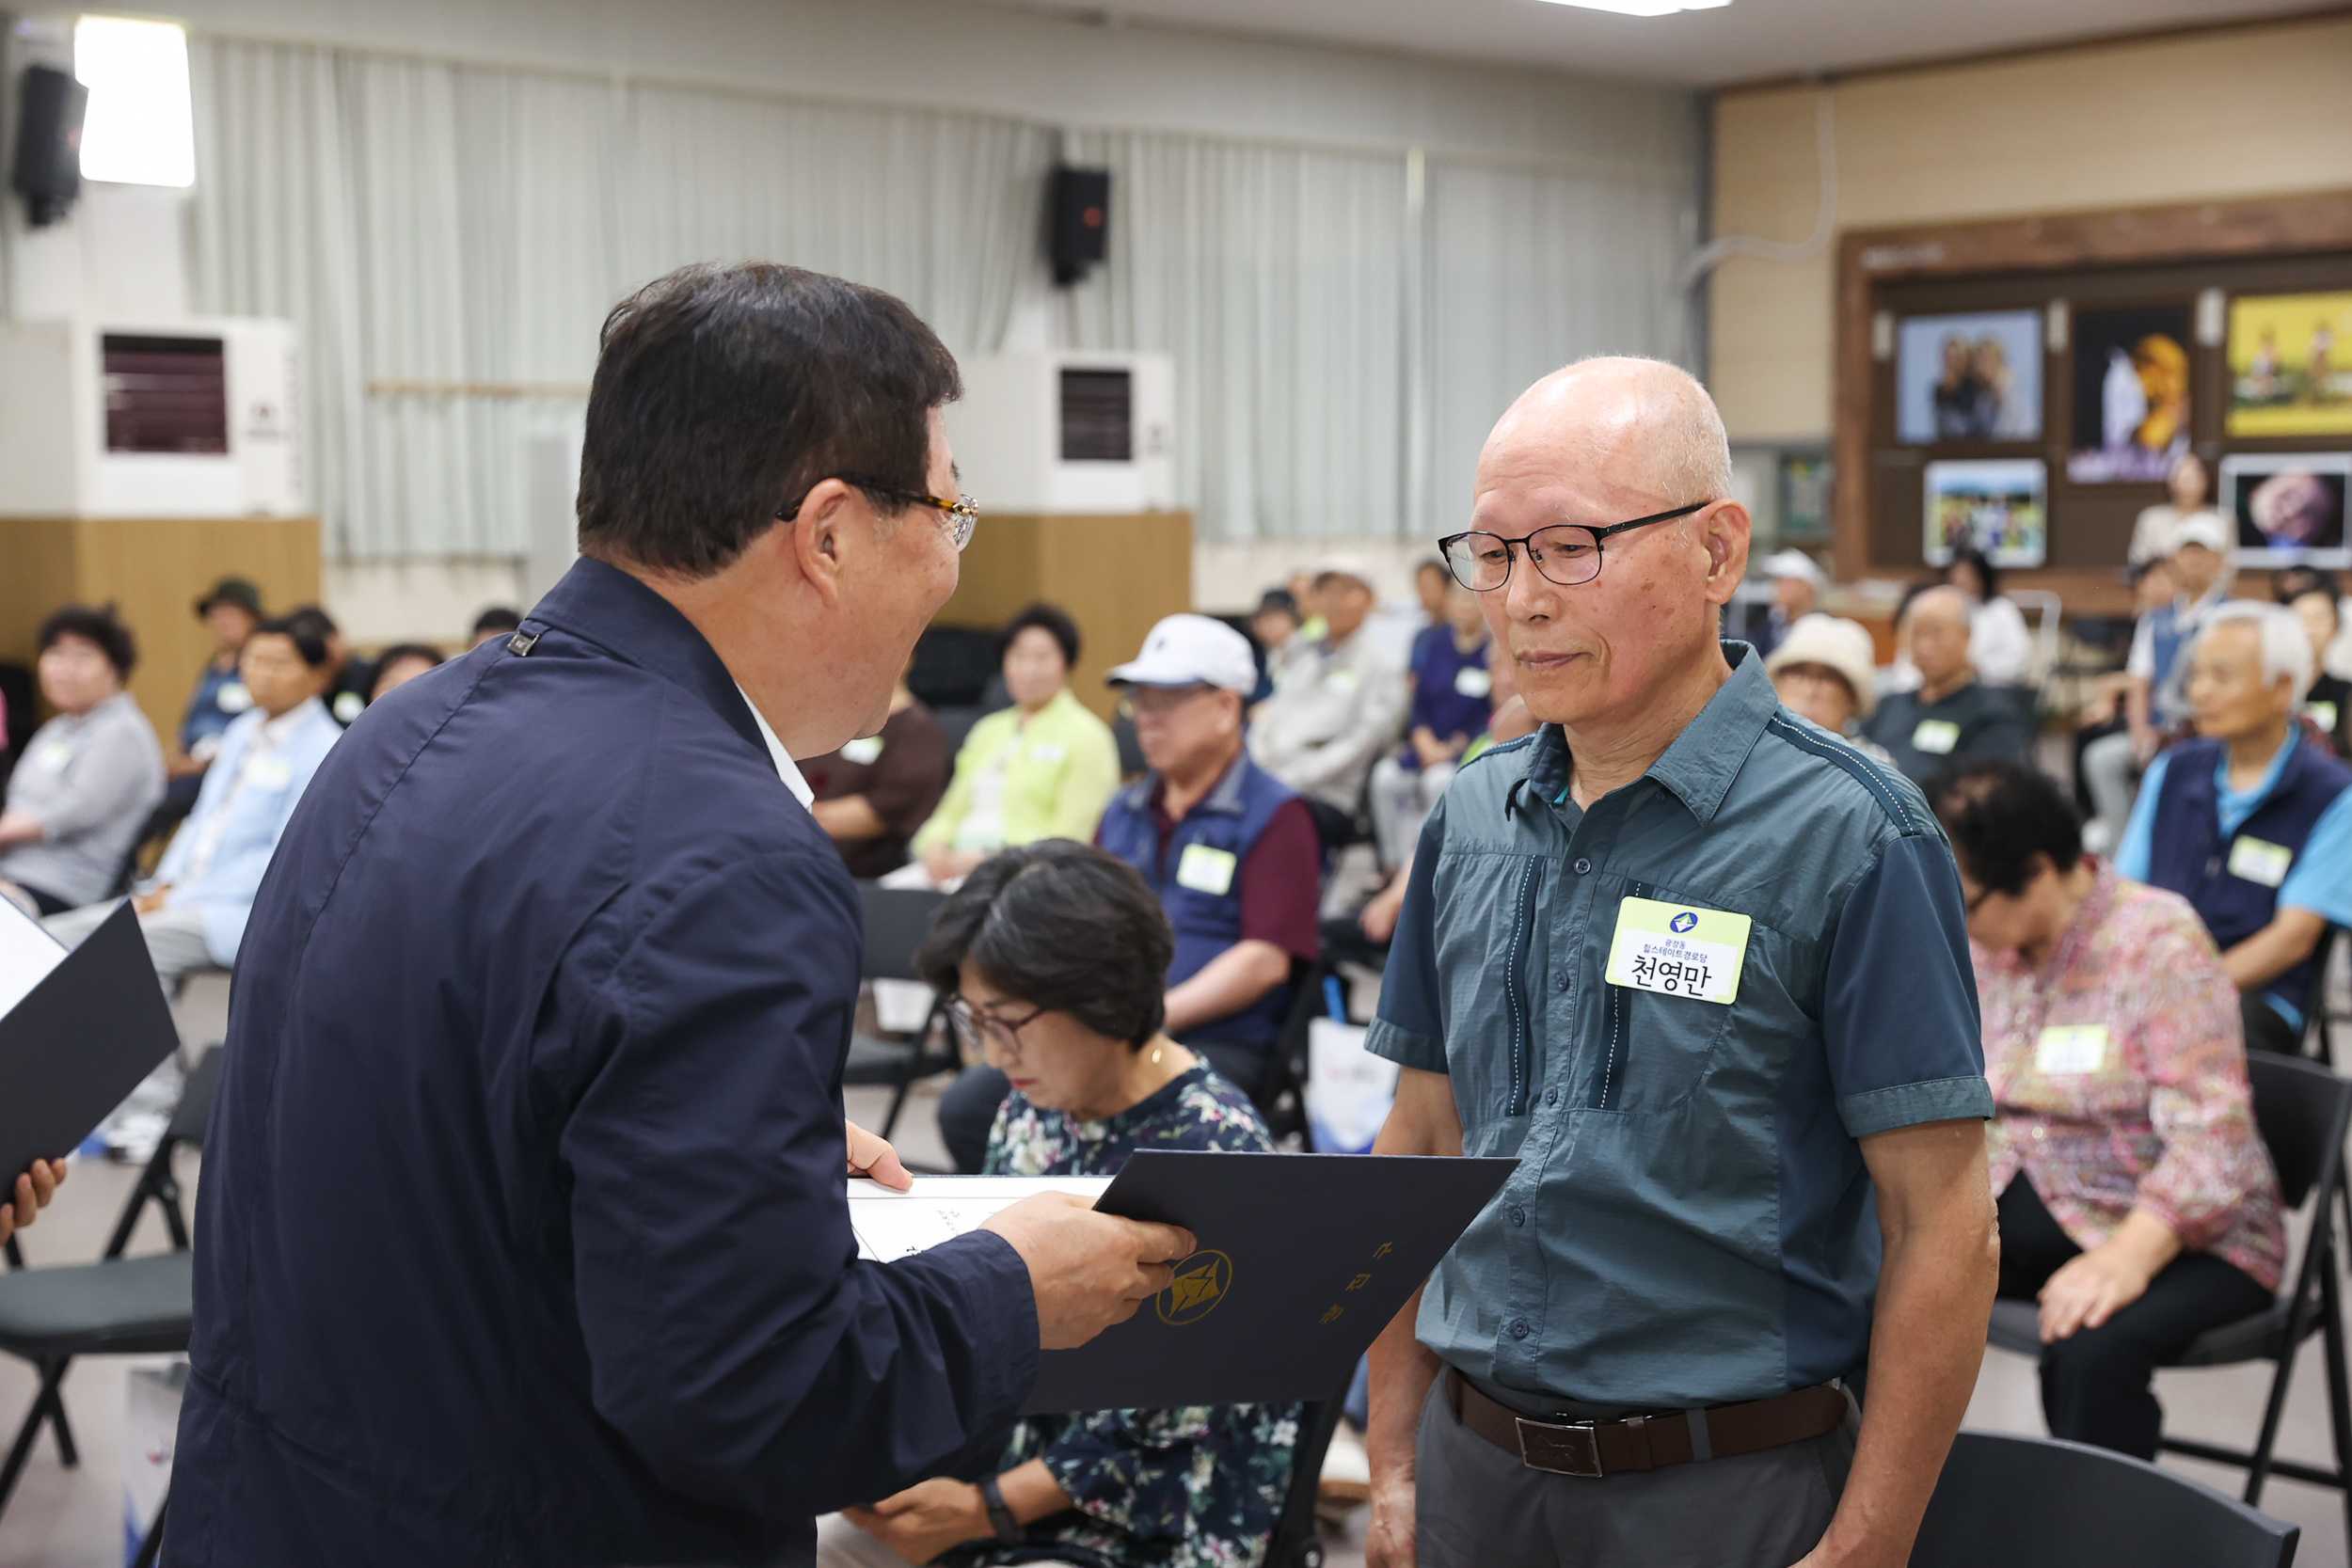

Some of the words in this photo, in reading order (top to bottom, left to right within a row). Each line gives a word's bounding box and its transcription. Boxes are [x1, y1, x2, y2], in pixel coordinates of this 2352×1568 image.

[1644, 943, 1708, 963] 힐스테이트경로당
[1665, 939, 1686, 949] 광장동
[1632, 955, 1711, 996] 천영만
